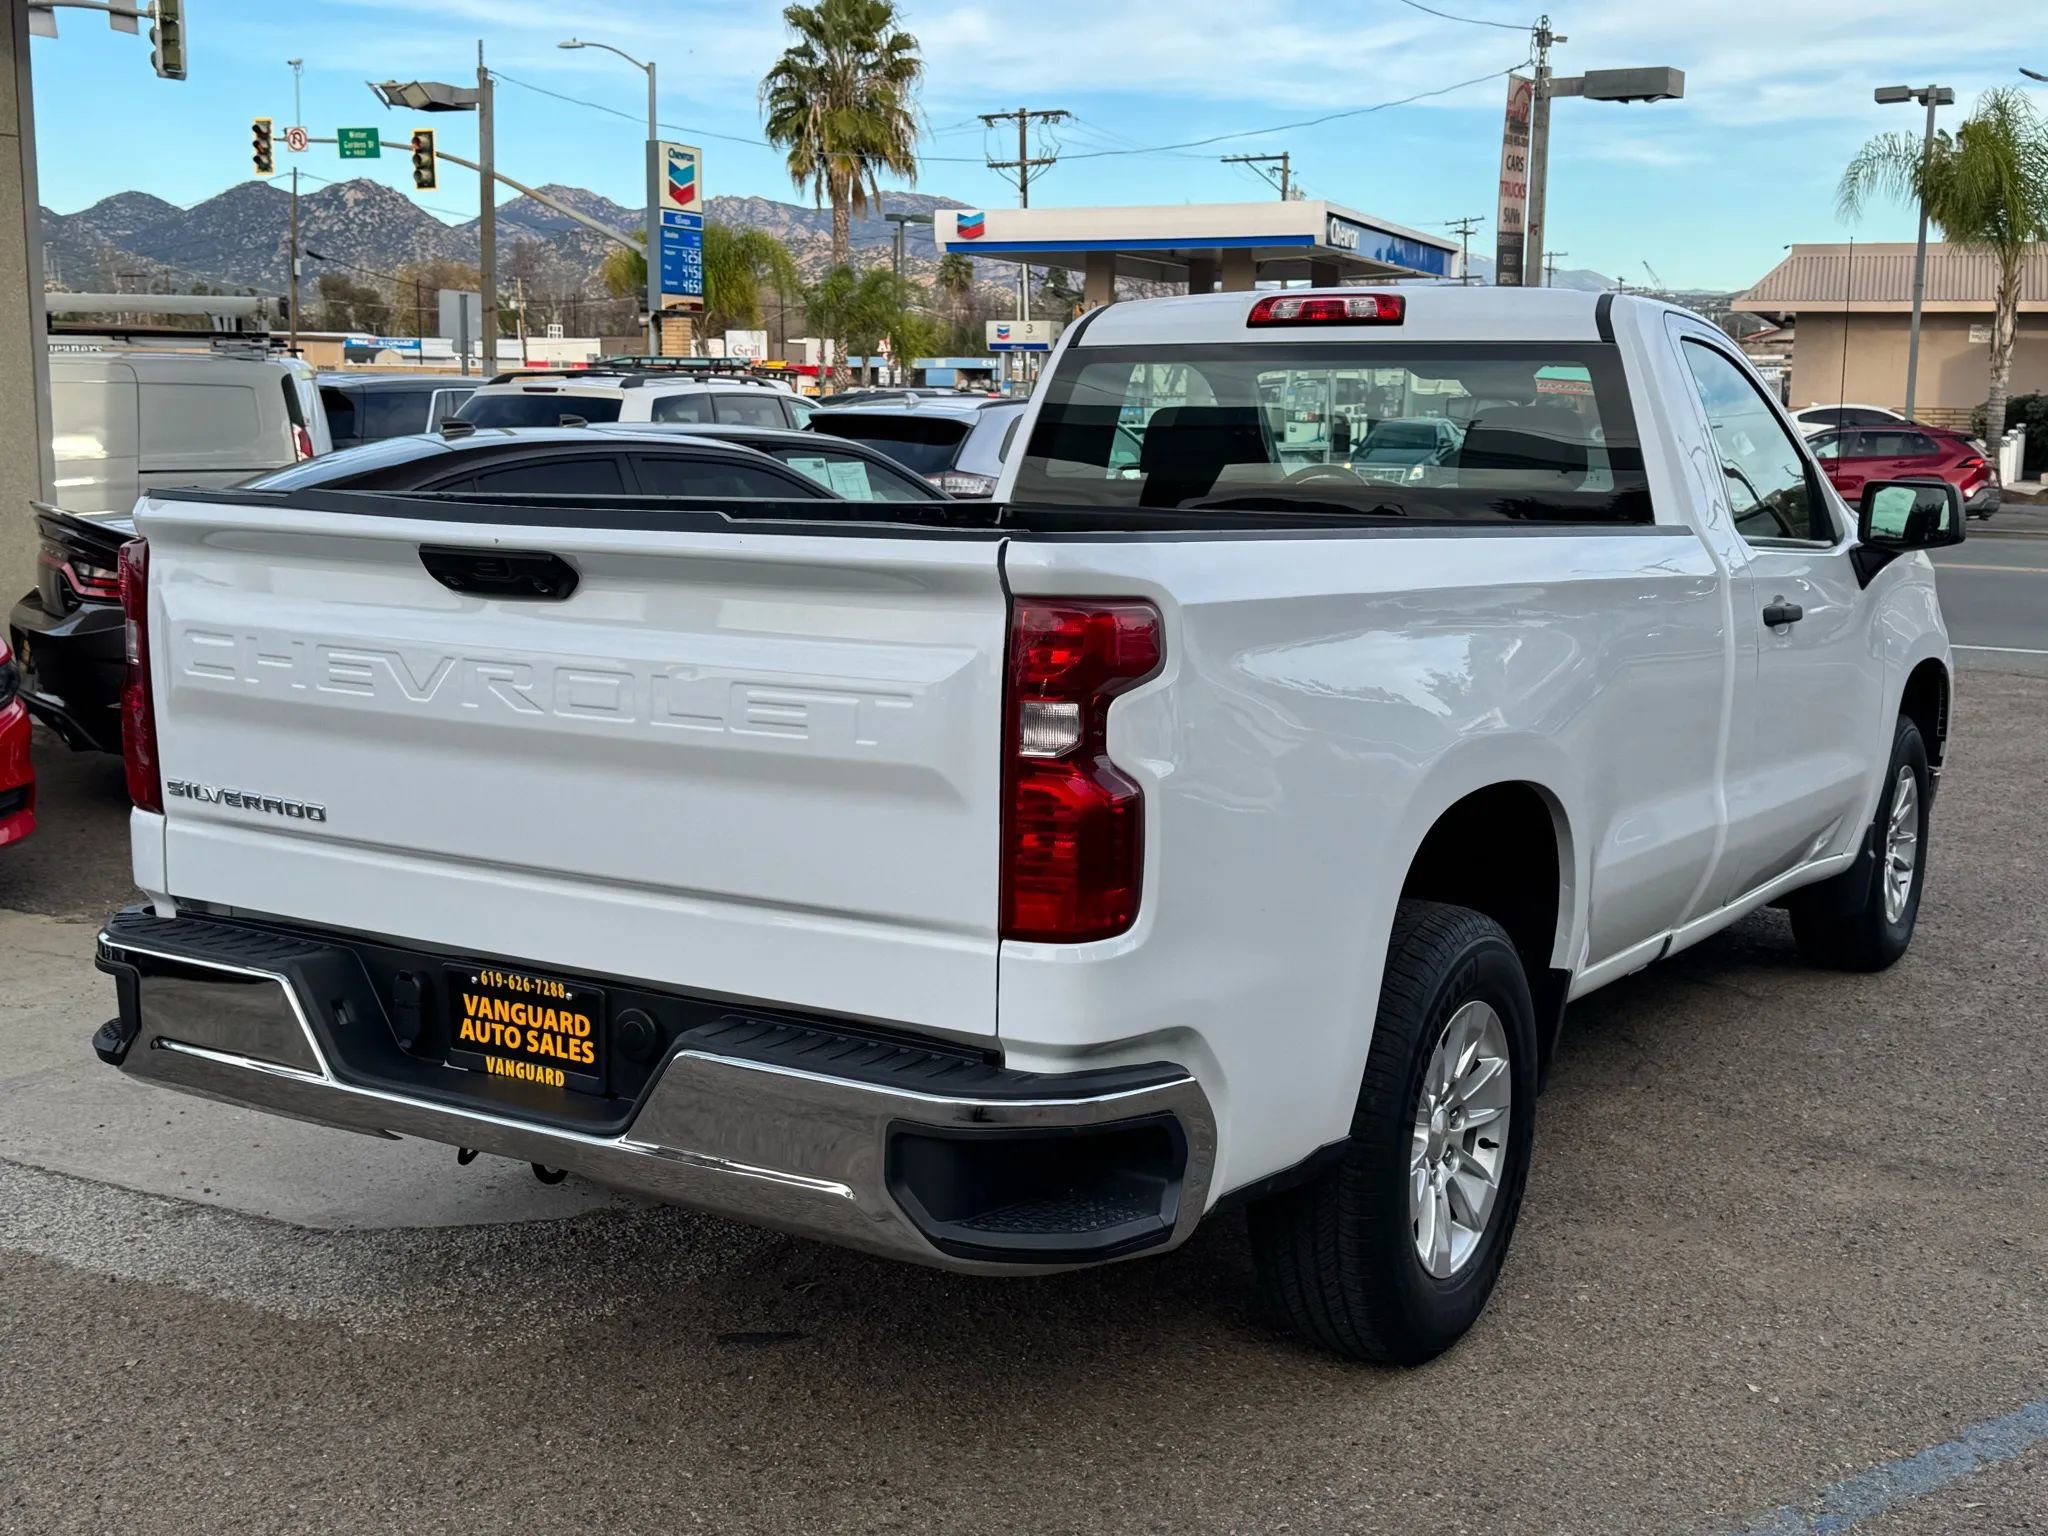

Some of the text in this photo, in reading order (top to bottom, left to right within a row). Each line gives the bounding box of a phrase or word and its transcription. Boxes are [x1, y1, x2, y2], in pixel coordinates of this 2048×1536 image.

[668, 147, 695, 162] Chevron
[1506, 154, 1524, 172] CARS
[1501, 181, 1526, 199] TRUCKS
[1330, 216, 1360, 250] Chevron
[1025, 323, 1034, 334] 3
[731, 344, 761, 357] Grill
[183, 628, 918, 748] CHEVROLET
[167, 777, 327, 823] SILVERADO
[480, 969, 565, 999] 619-626-7288
[463, 993, 591, 1037] VANGUARD
[459, 1018, 595, 1064] AUTO SALES
[485, 1055, 565, 1087] VANGUARD
